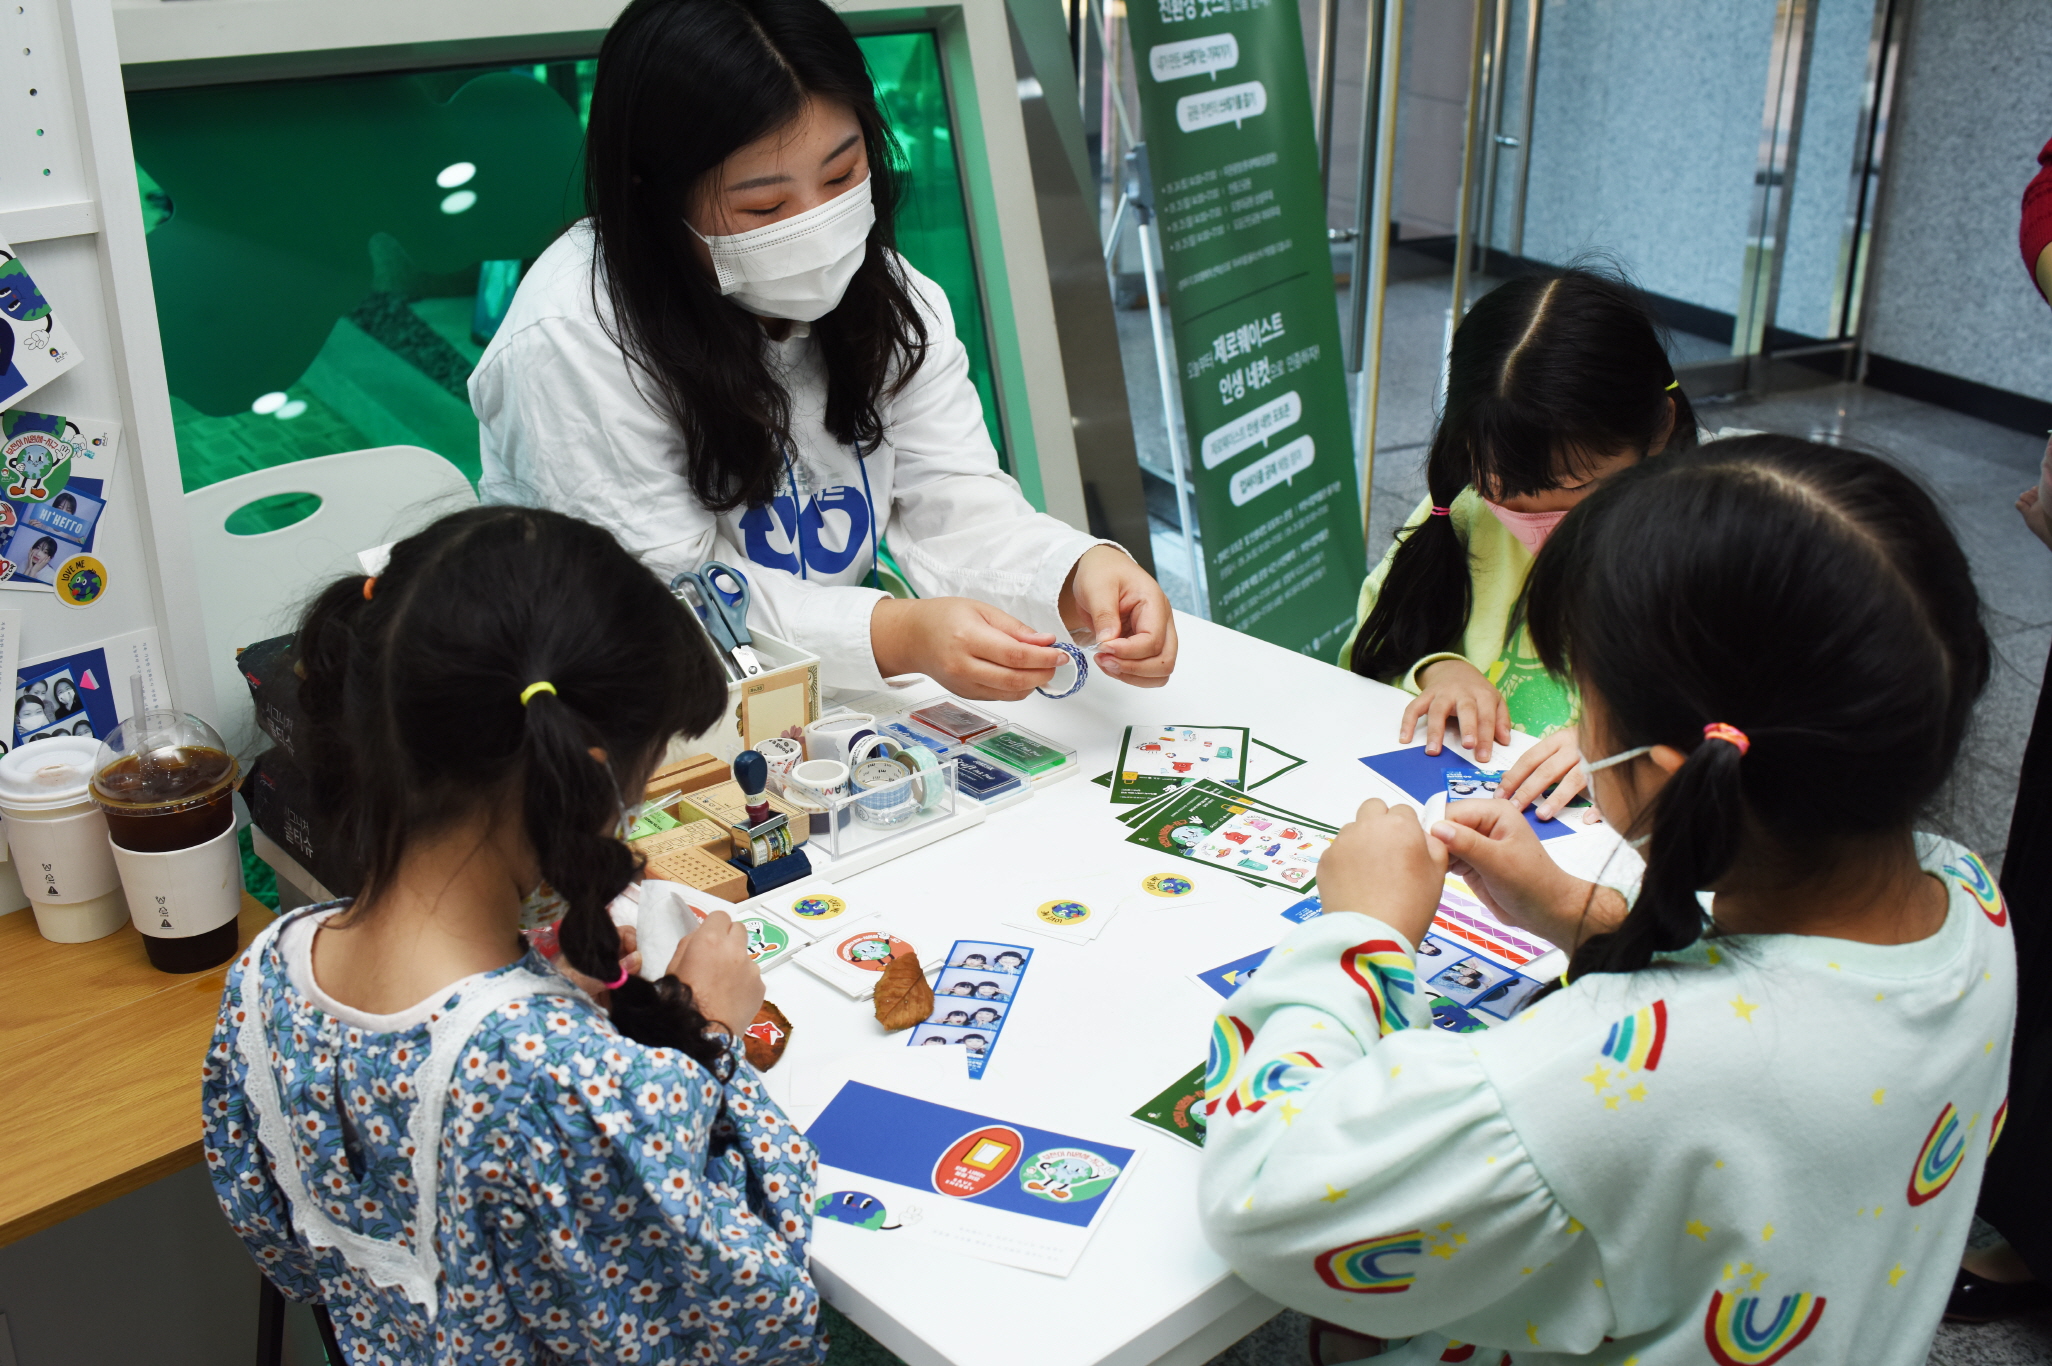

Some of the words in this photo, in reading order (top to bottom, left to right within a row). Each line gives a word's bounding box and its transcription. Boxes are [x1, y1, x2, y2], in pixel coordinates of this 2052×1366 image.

[1212, 311, 1286, 364] 제로웨이스트
[1218, 368, 1246, 406] 인생
[62, 565, 76, 582] LOVE
[75, 559, 86, 570] ME
